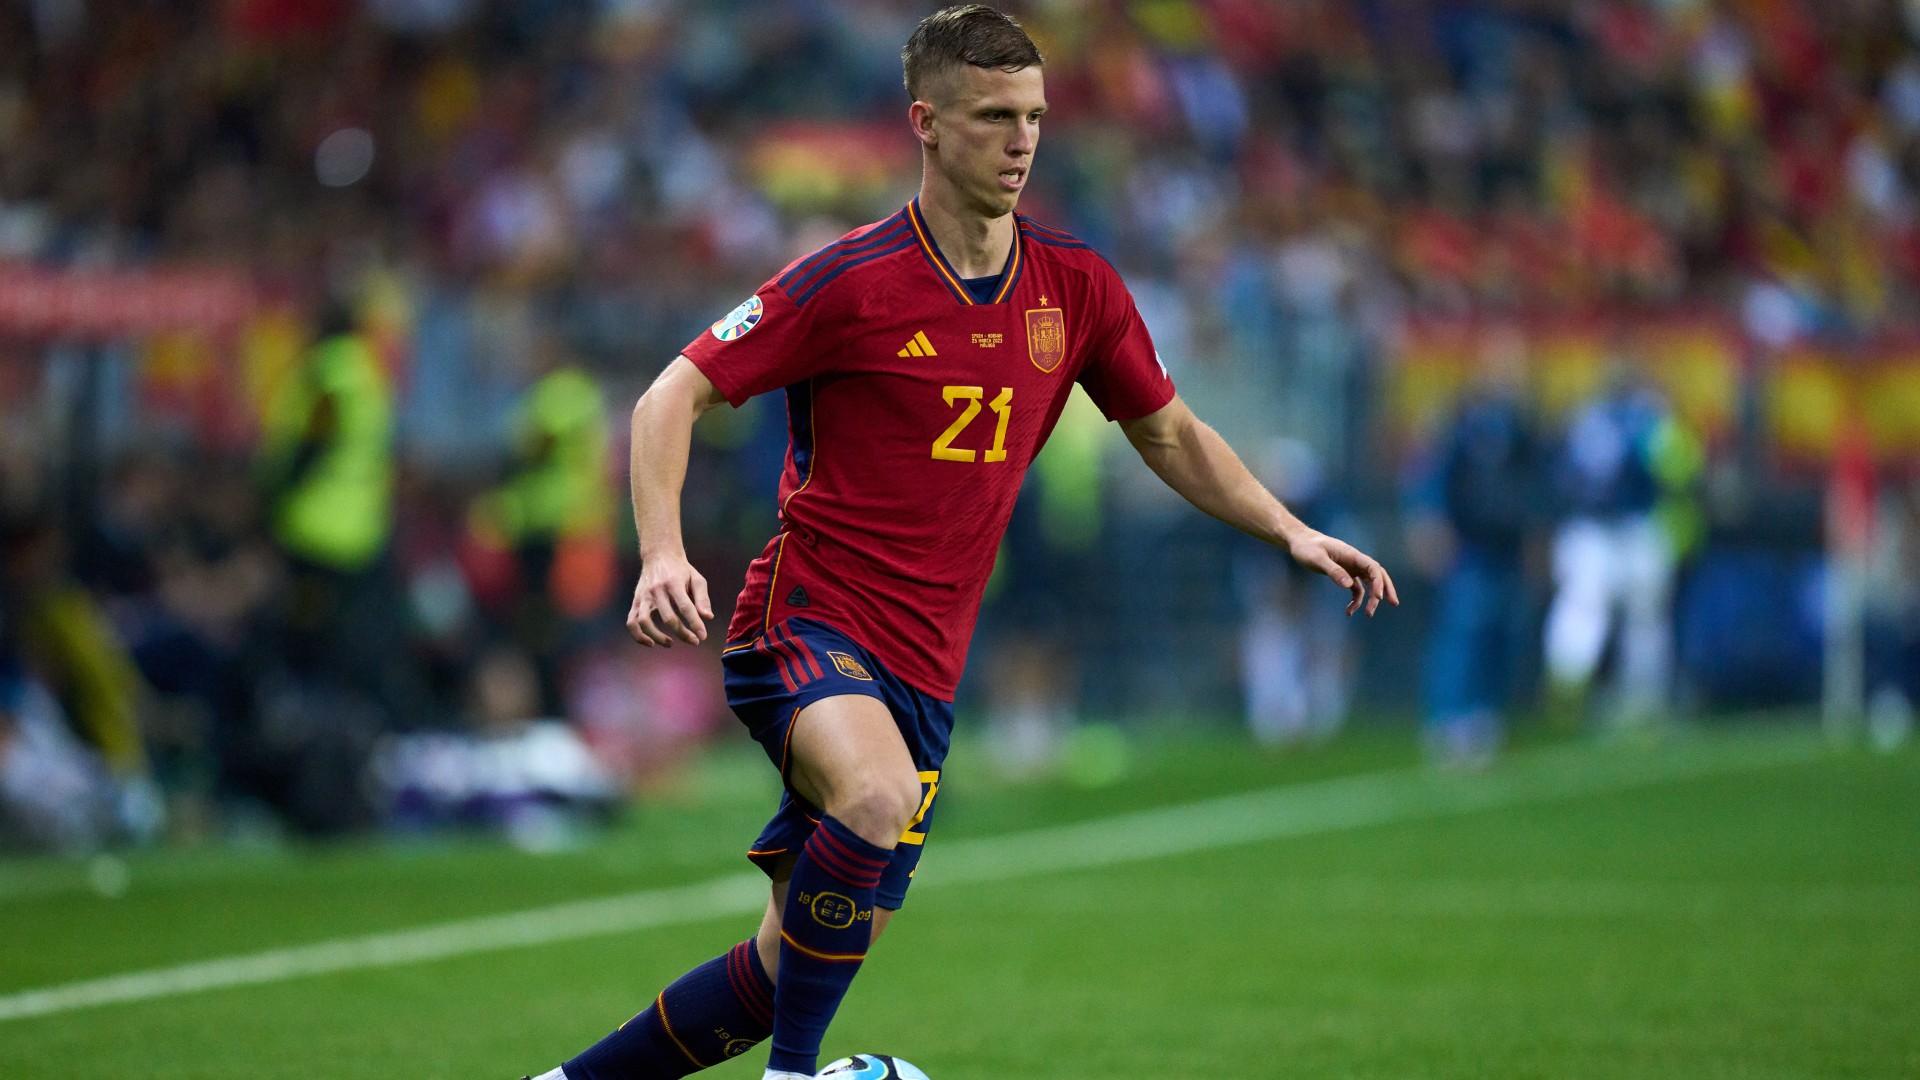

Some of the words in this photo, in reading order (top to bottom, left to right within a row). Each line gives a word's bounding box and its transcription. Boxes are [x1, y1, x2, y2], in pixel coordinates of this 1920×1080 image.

[931, 385, 1013, 462] 21
[899, 770, 940, 845] 2
[798, 892, 811, 904] 19
[857, 910, 871, 920] 09
[714, 1026, 731, 1039] 19
